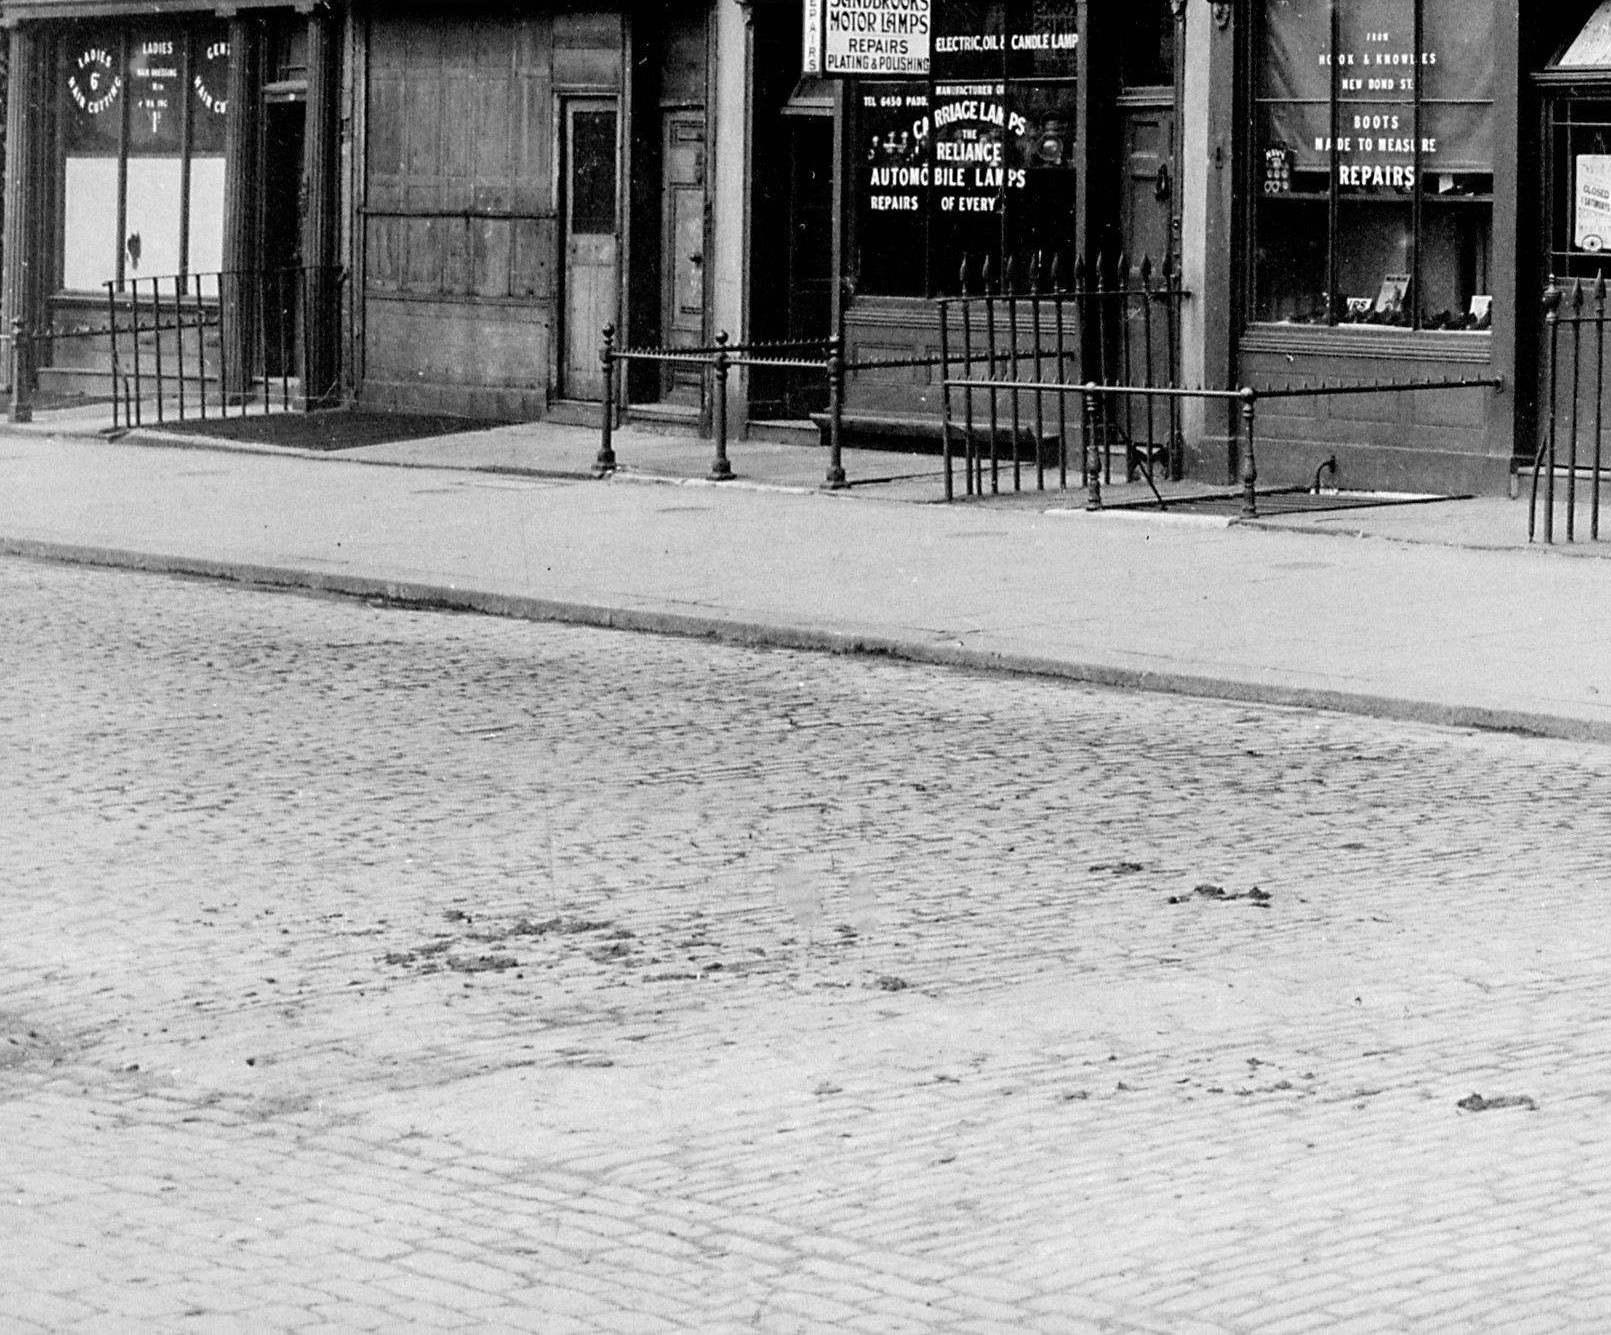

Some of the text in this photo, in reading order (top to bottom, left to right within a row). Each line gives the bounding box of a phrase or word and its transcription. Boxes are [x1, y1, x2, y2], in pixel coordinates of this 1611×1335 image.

[830, 11, 929, 35] MOTOR LAMPS
[1011, 34, 1049, 50] CANDLE
[1366, 32, 1389, 42] FROM
[142, 42, 173, 55] LADIES
[849, 38, 909, 55] REPAIRS
[78, 49, 111, 68] LADIES
[828, 54, 930, 74] PLATING & POLISHING
[1363, 53, 1370, 65] &
[1376, 52, 1436, 66] KNOWLES
[935, 85, 993, 96] MANUFACTURER
[1342, 78, 1362, 90] NEW
[1368, 78, 1394, 90] BOND
[69, 76, 121, 113] HAIR CUTTING
[863, 96, 877, 107] TEL
[913, 100, 1026, 139] CARRIAGE LAMPS
[1354, 115, 1399, 129] BOOTS
[962, 129, 977, 140] THE
[936, 142, 1002, 162] RELIANCE
[1358, 137, 1372, 151] TO
[870, 167, 1026, 188] AUTOMOBILE LAMPS
[1339, 165, 1415, 186] REPAIRS
[870, 195, 996, 212] REPAIRS OF EVERY
